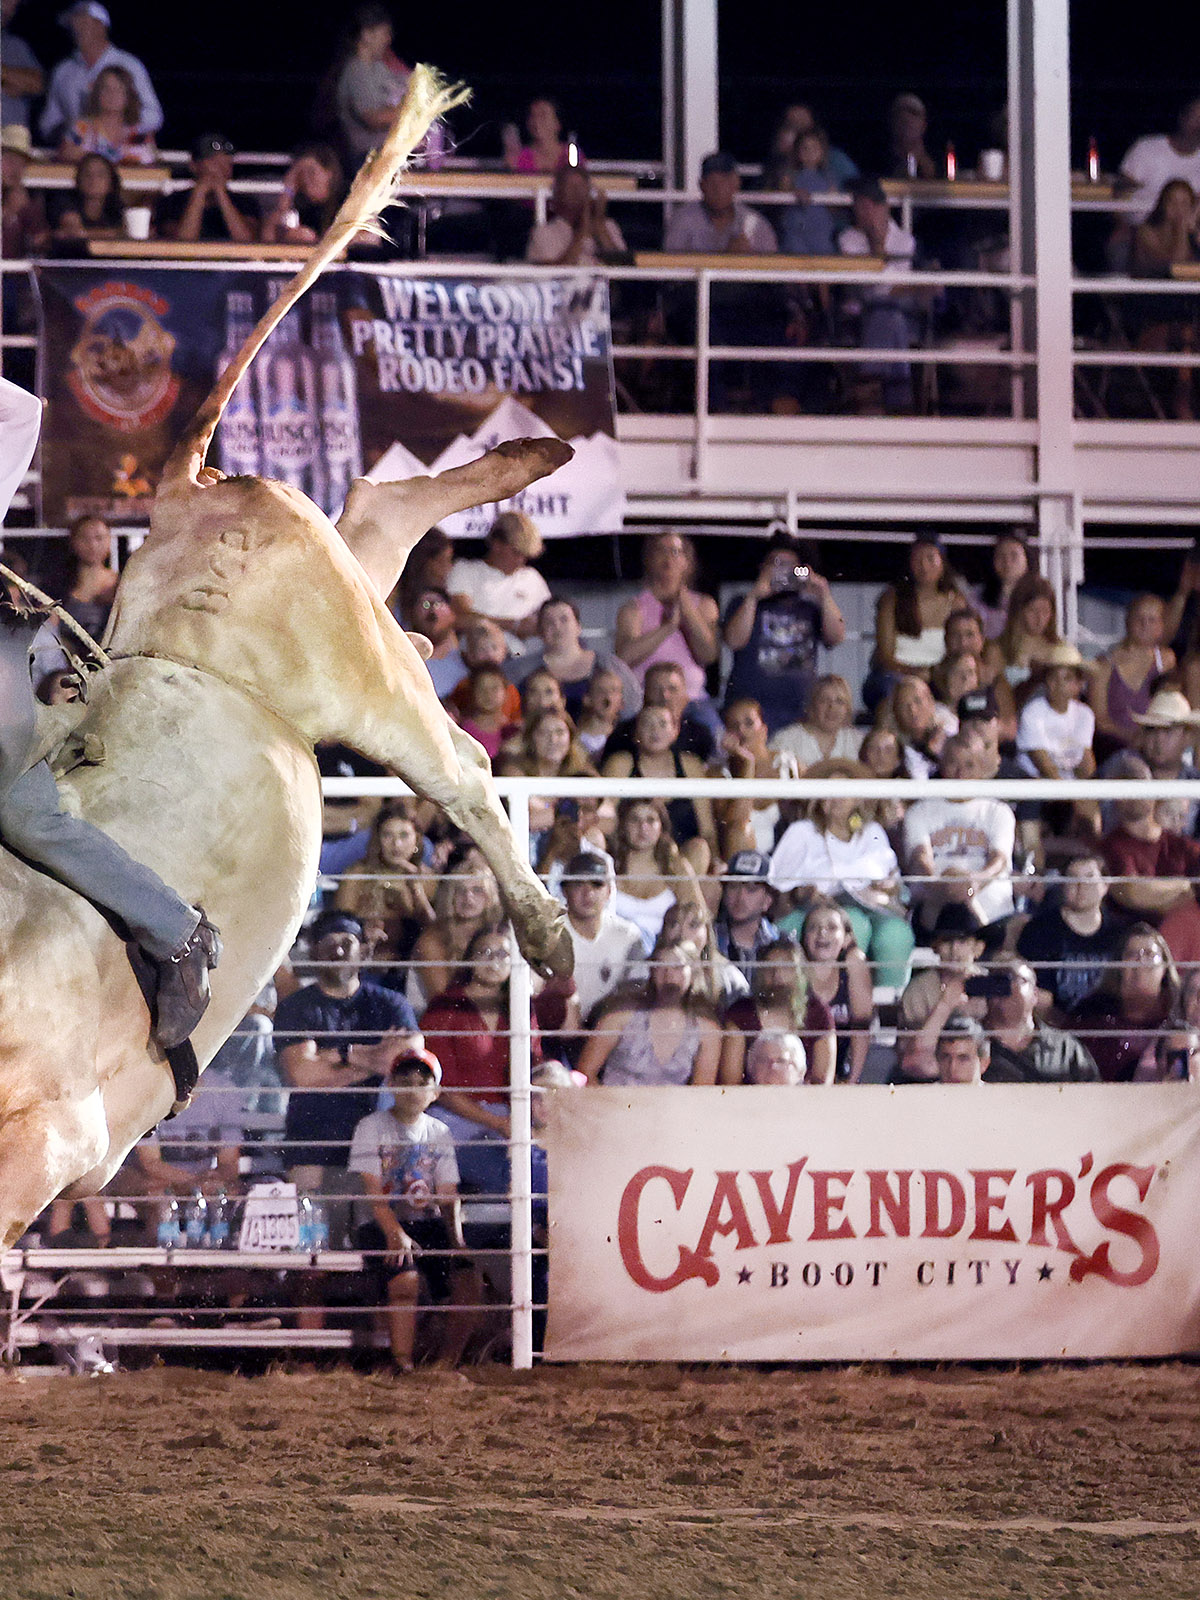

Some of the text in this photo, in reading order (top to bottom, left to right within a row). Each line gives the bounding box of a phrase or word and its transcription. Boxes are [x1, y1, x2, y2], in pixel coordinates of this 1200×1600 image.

[377, 276, 564, 323] WELCOME
[353, 319, 601, 359] PRETTY PRAIRIE
[378, 356, 586, 393] RODEO FANS!
[618, 1151, 1160, 1292] CAVENDER'S
[770, 1259, 1025, 1288] BOOT CITY
